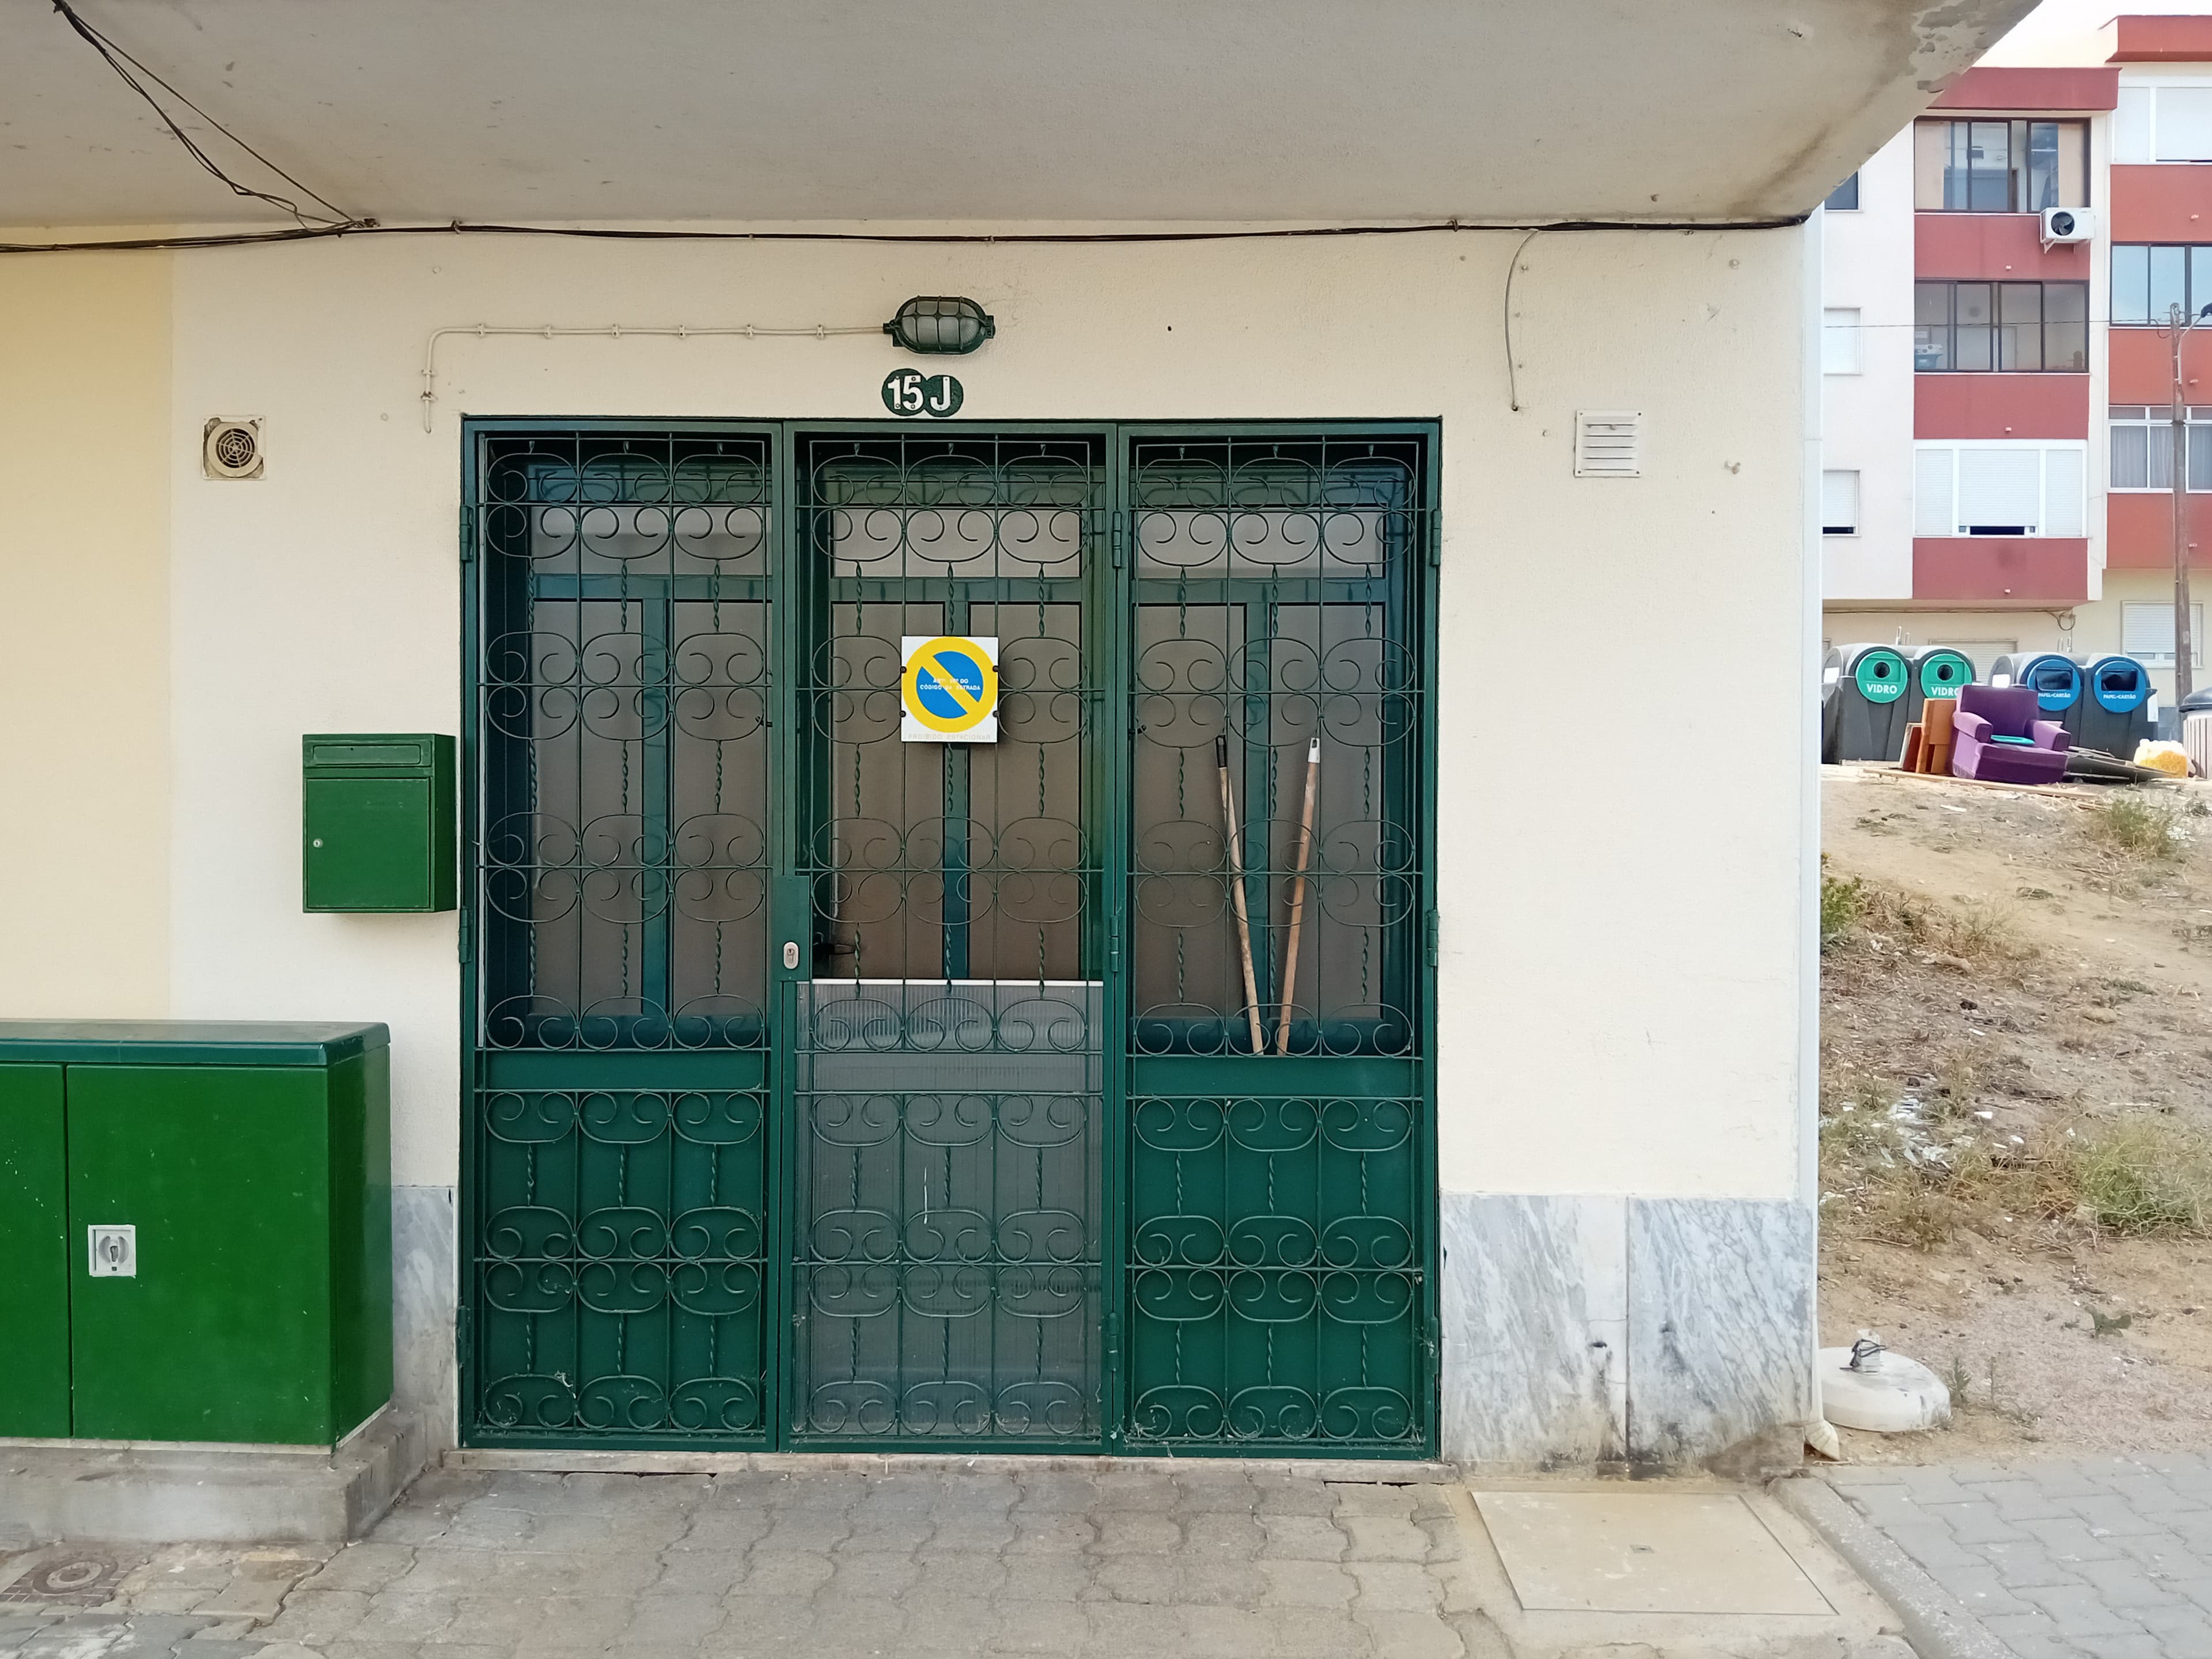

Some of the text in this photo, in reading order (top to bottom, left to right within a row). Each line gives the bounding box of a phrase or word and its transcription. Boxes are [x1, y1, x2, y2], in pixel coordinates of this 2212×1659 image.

[887, 375, 950, 411] 15 J
[1866, 683, 1897, 695] VIDRO
